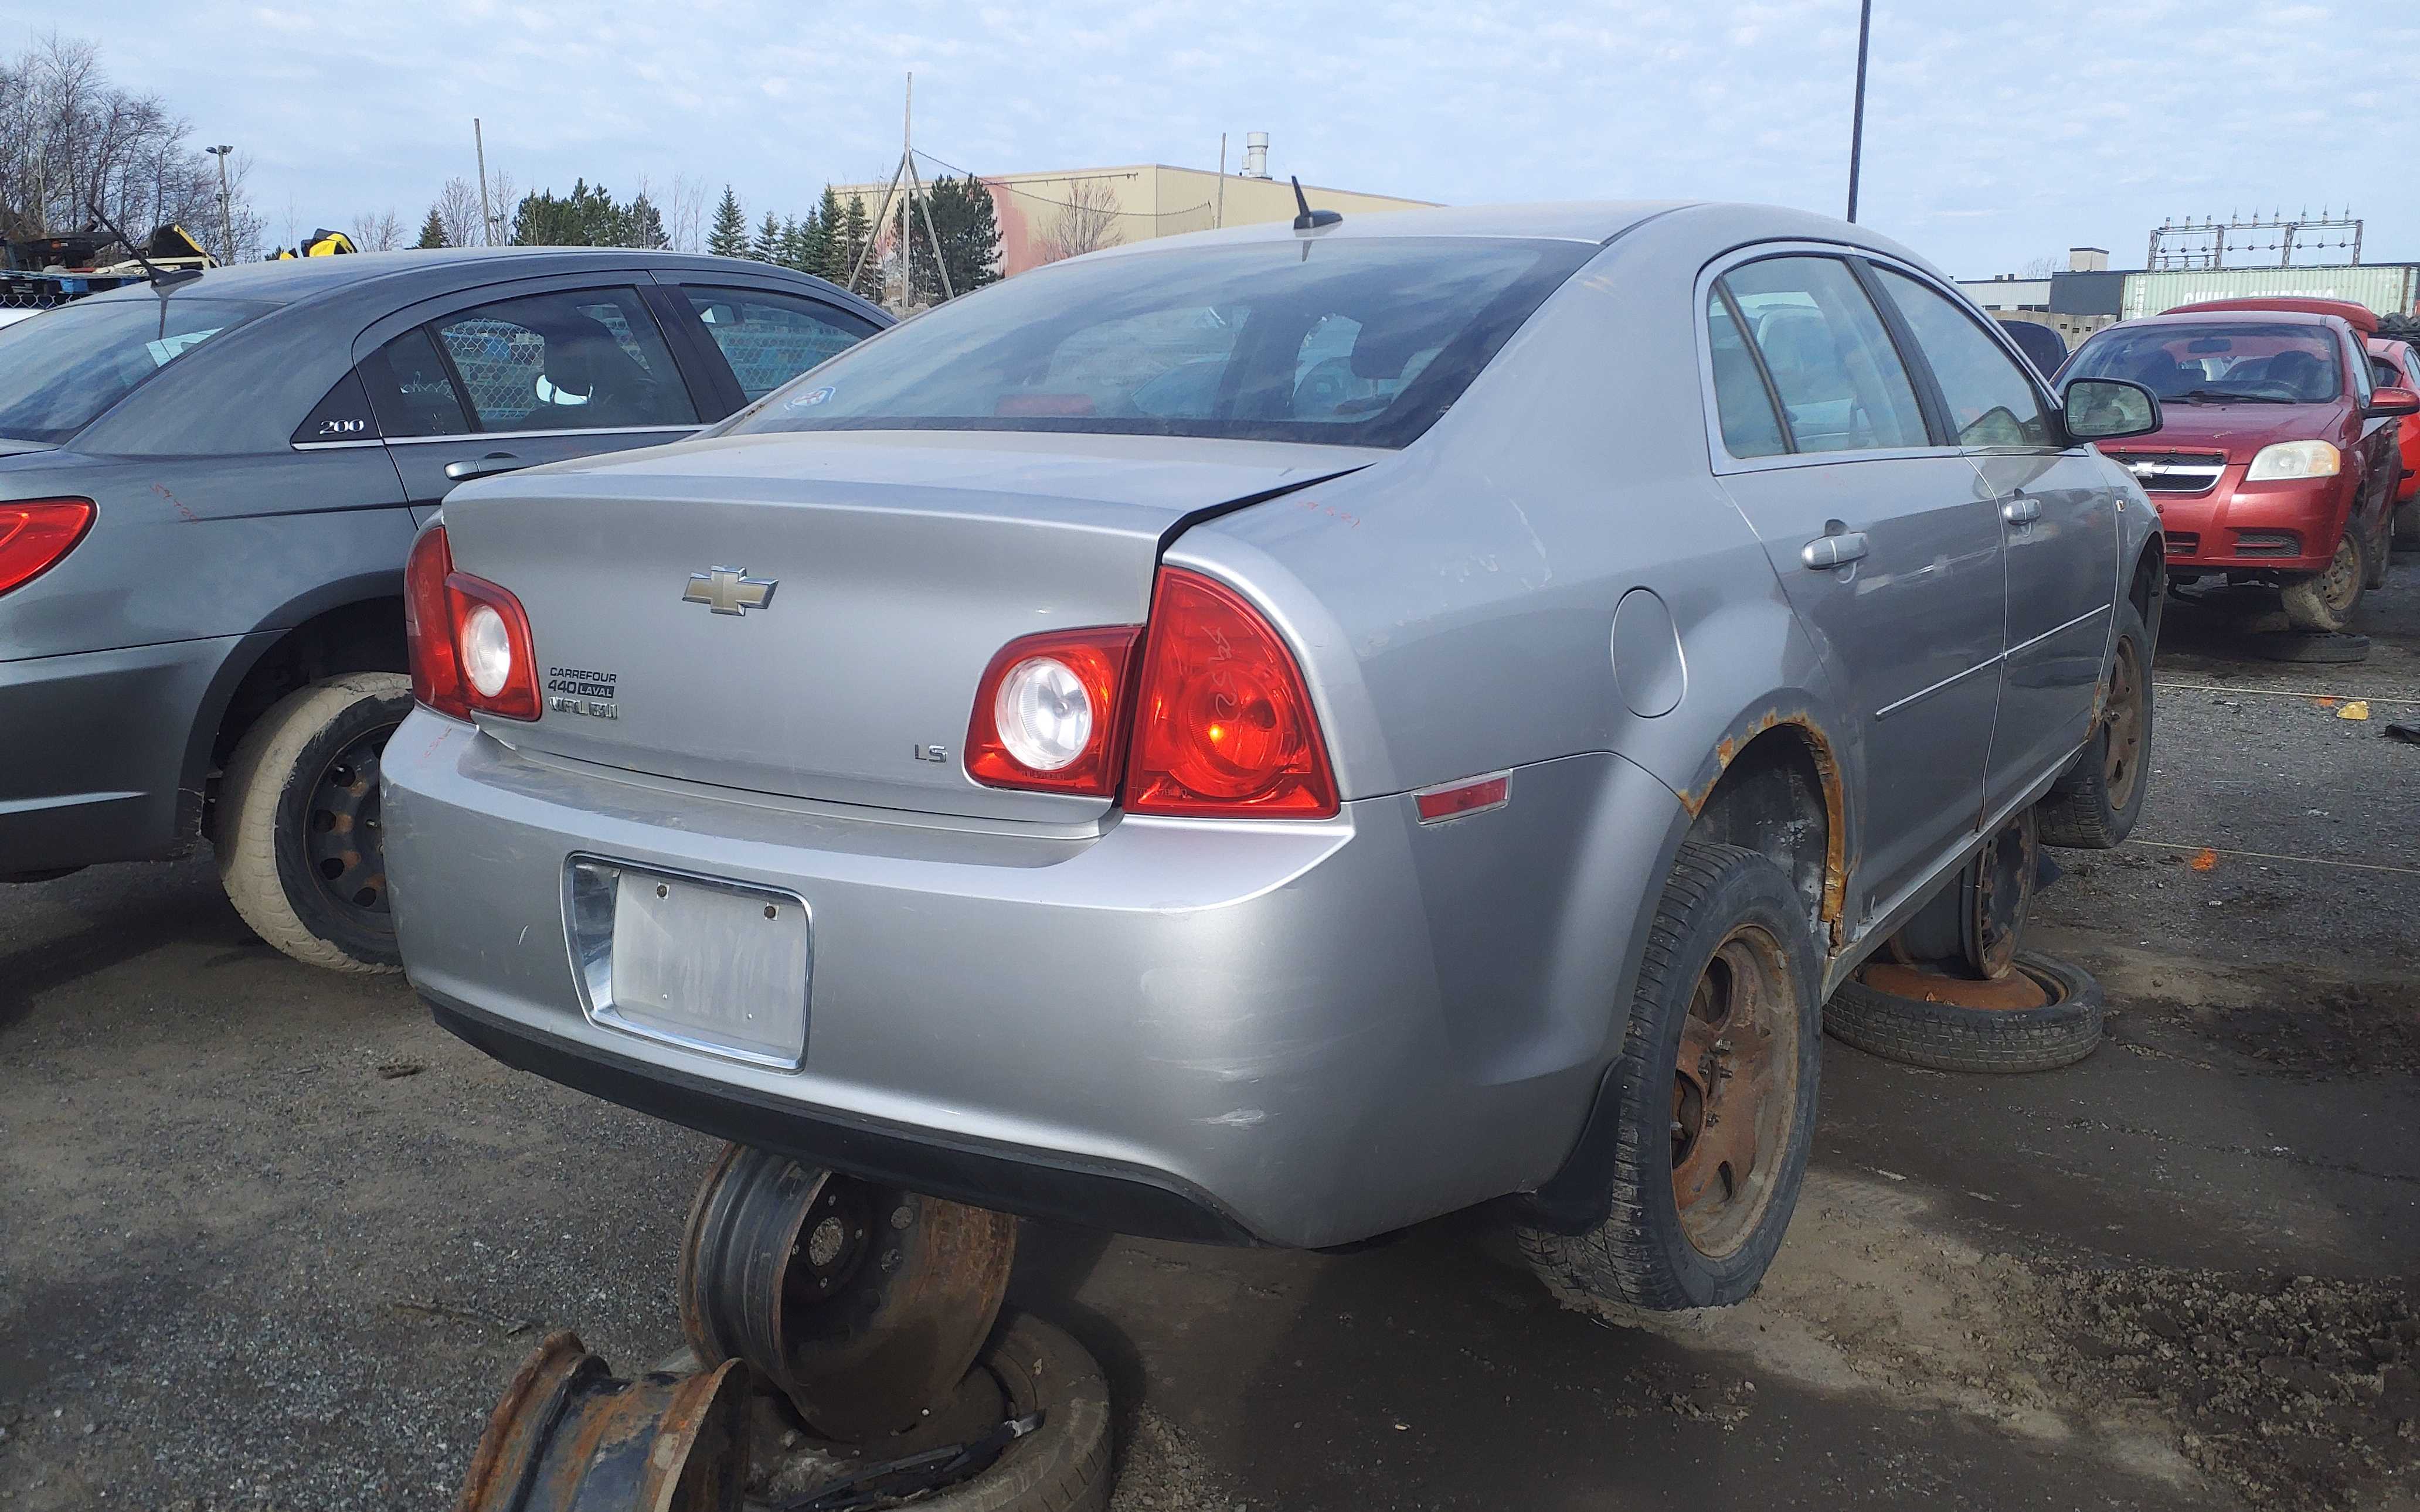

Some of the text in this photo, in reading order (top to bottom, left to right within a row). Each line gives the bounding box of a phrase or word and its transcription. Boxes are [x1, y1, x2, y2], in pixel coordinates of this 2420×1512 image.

[319, 419, 364, 434] 200
[550, 667, 617, 683] CARREFOUR
[548, 679, 613, 697] 440 LAVAL
[915, 744, 947, 763] LS
